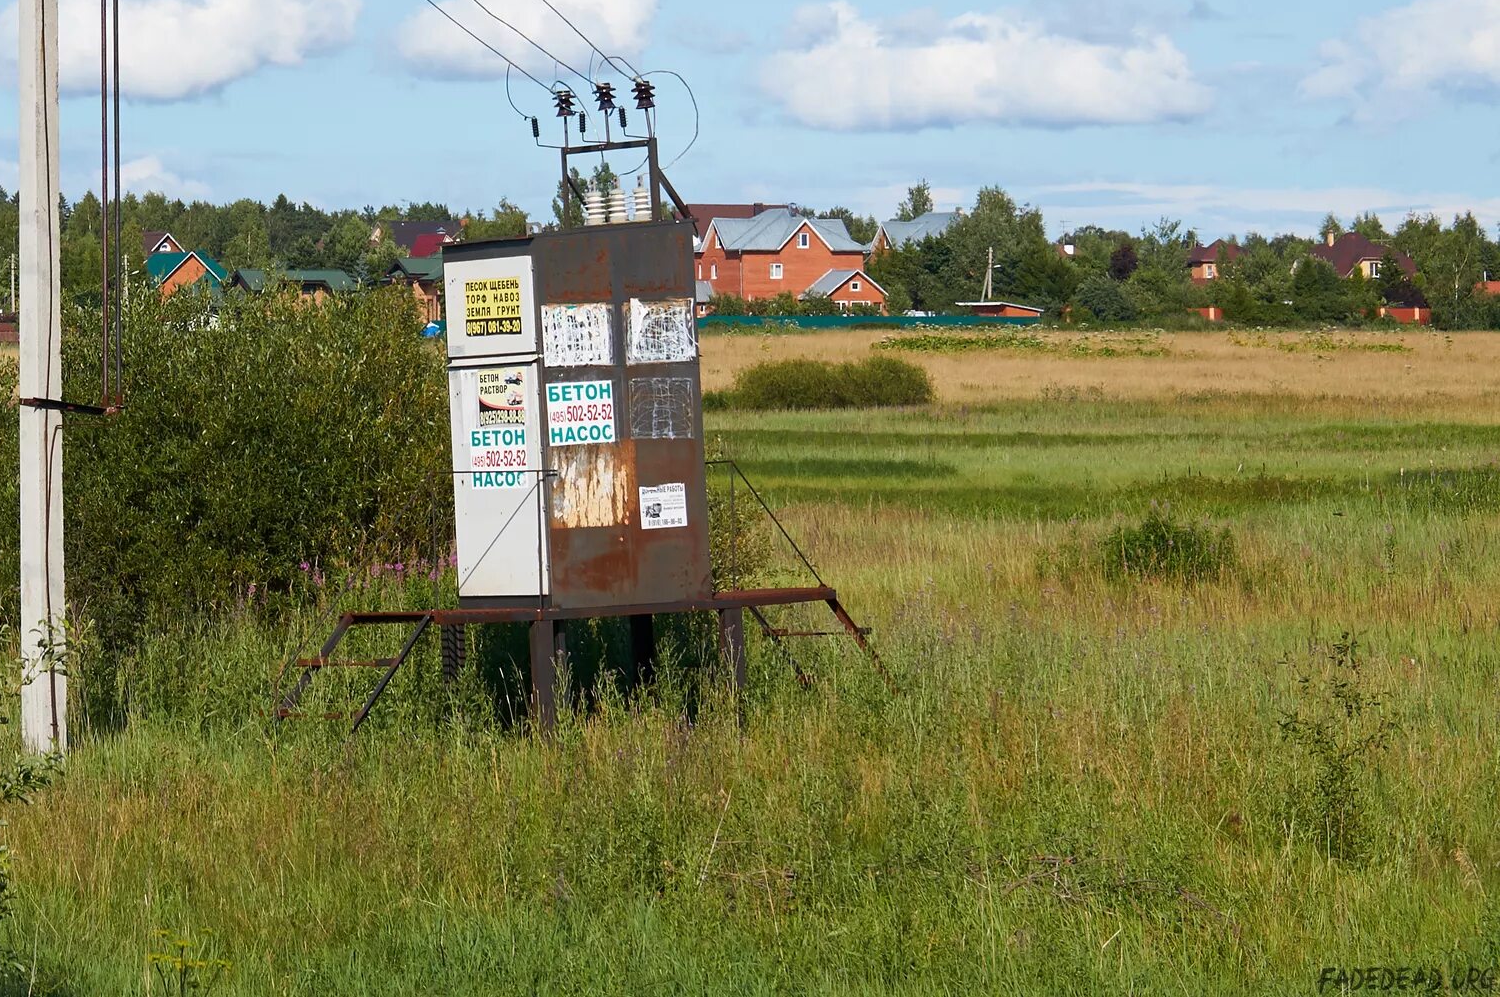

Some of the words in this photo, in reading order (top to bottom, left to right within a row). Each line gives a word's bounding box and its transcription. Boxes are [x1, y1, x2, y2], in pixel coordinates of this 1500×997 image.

[465, 282, 488, 292] ПЕСОК
[490, 279, 519, 292] ЩЕБЕНЬ
[466, 294, 488, 304] ТОРФ
[494, 292, 520, 303] НАВОЗ
[466, 306, 491, 317] ЗЕМЛЯ
[497, 305, 520, 316] ГРУНТ
[479, 373, 499, 383] БЕТОН
[480, 385, 508, 395] РАСТВОР
[548, 383, 611, 402] БЕТОН
[471, 429, 525, 447] БЕТОН
[551, 424, 613, 443] НАСОС
[667, 484, 684, 493] РАБОТЫ
